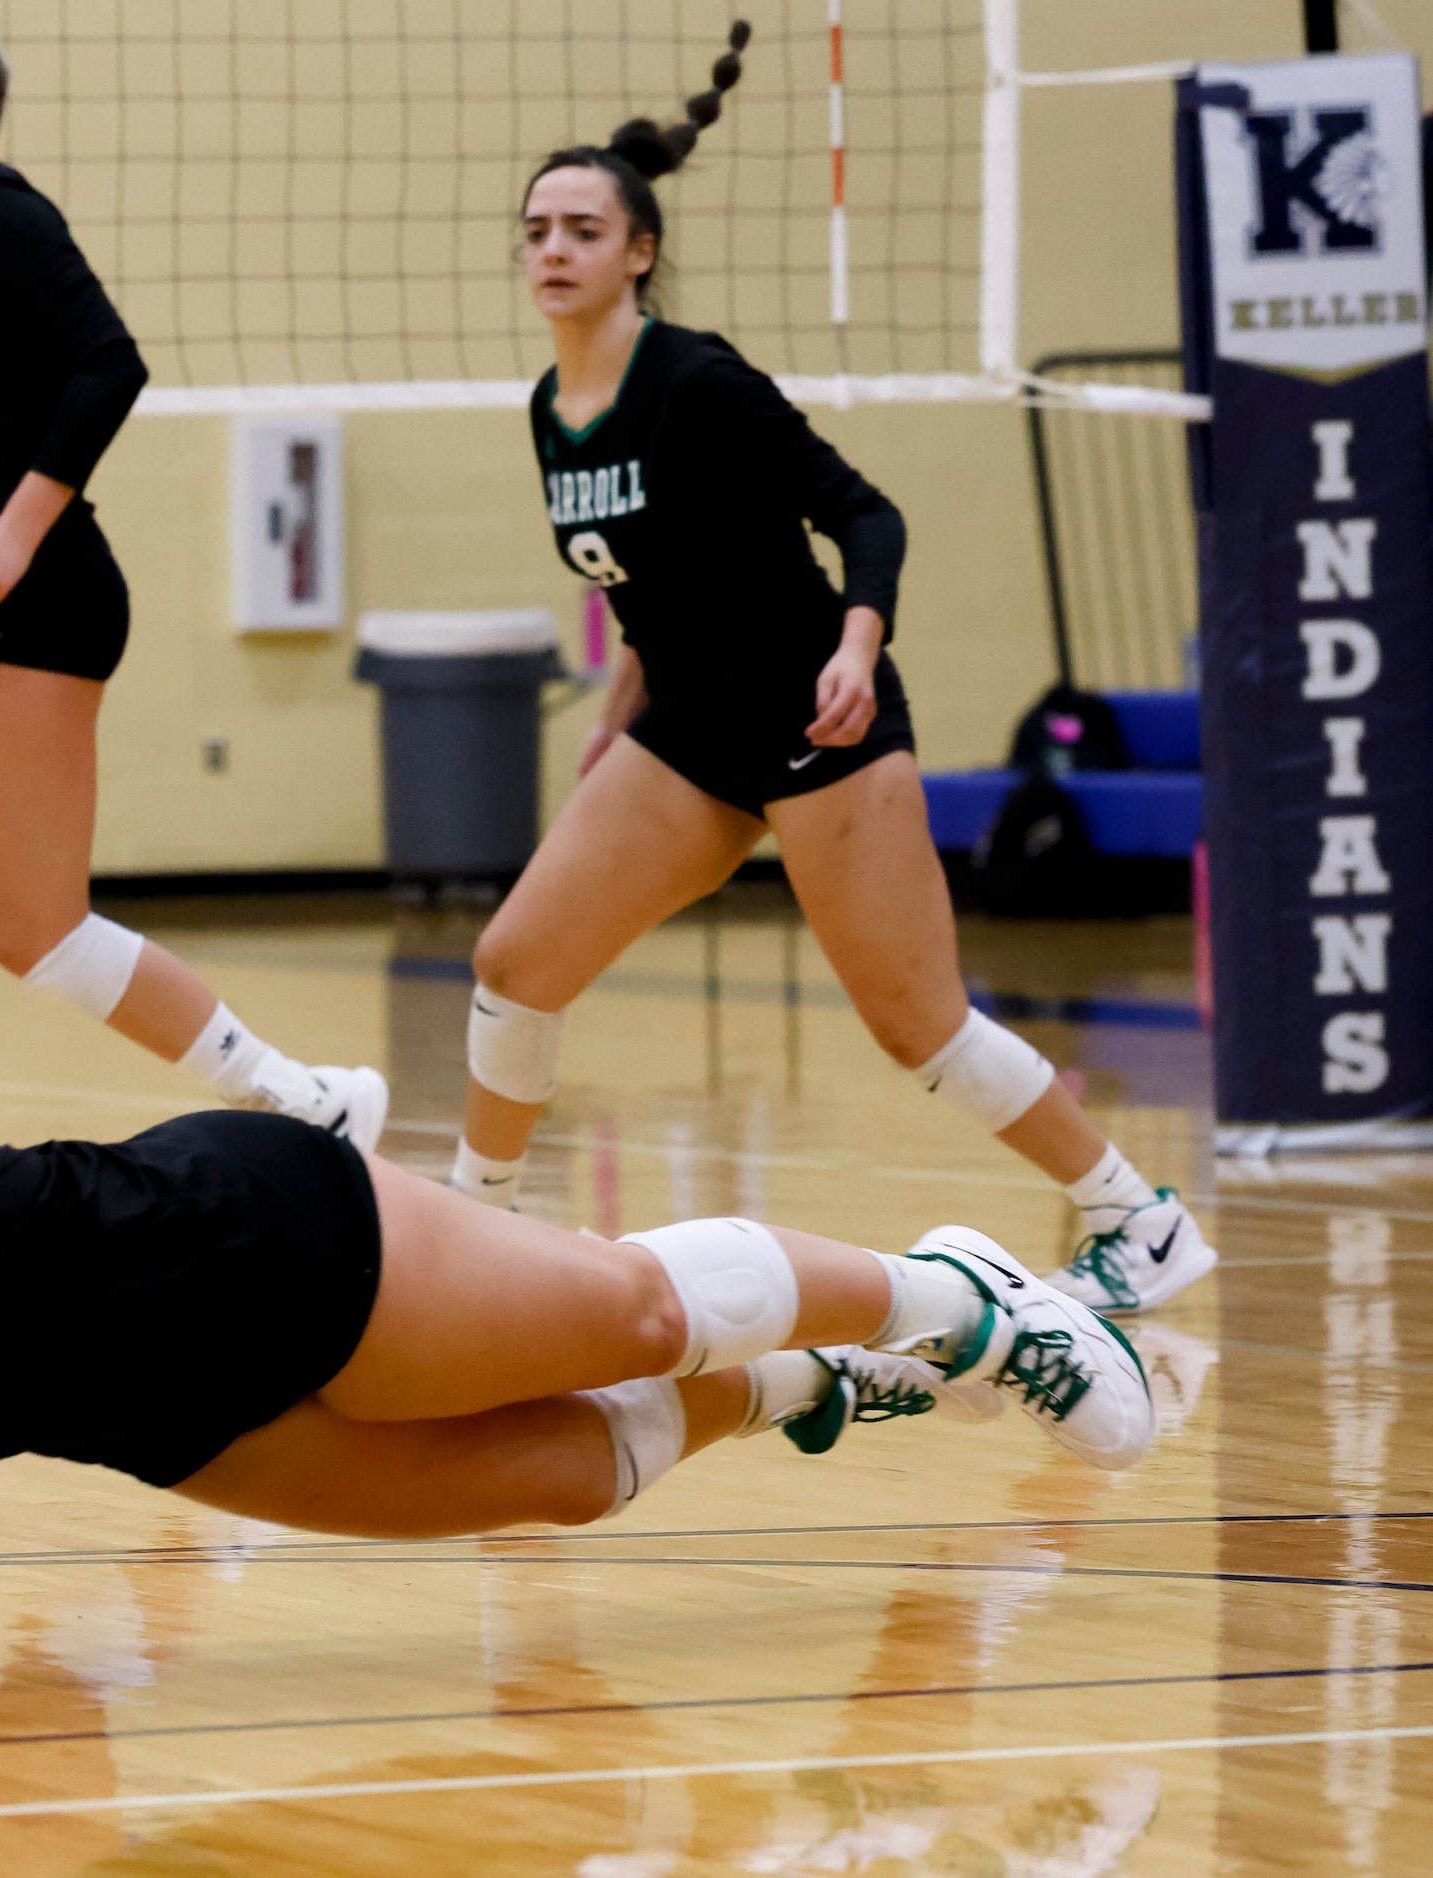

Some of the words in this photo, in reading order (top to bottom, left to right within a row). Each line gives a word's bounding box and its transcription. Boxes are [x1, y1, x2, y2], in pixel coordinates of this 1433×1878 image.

[1244, 106, 1379, 257] K
[1230, 293, 1420, 331] KELLER
[548, 459, 646, 525] ARROLL
[1295, 419, 1393, 1094] INDIANS
